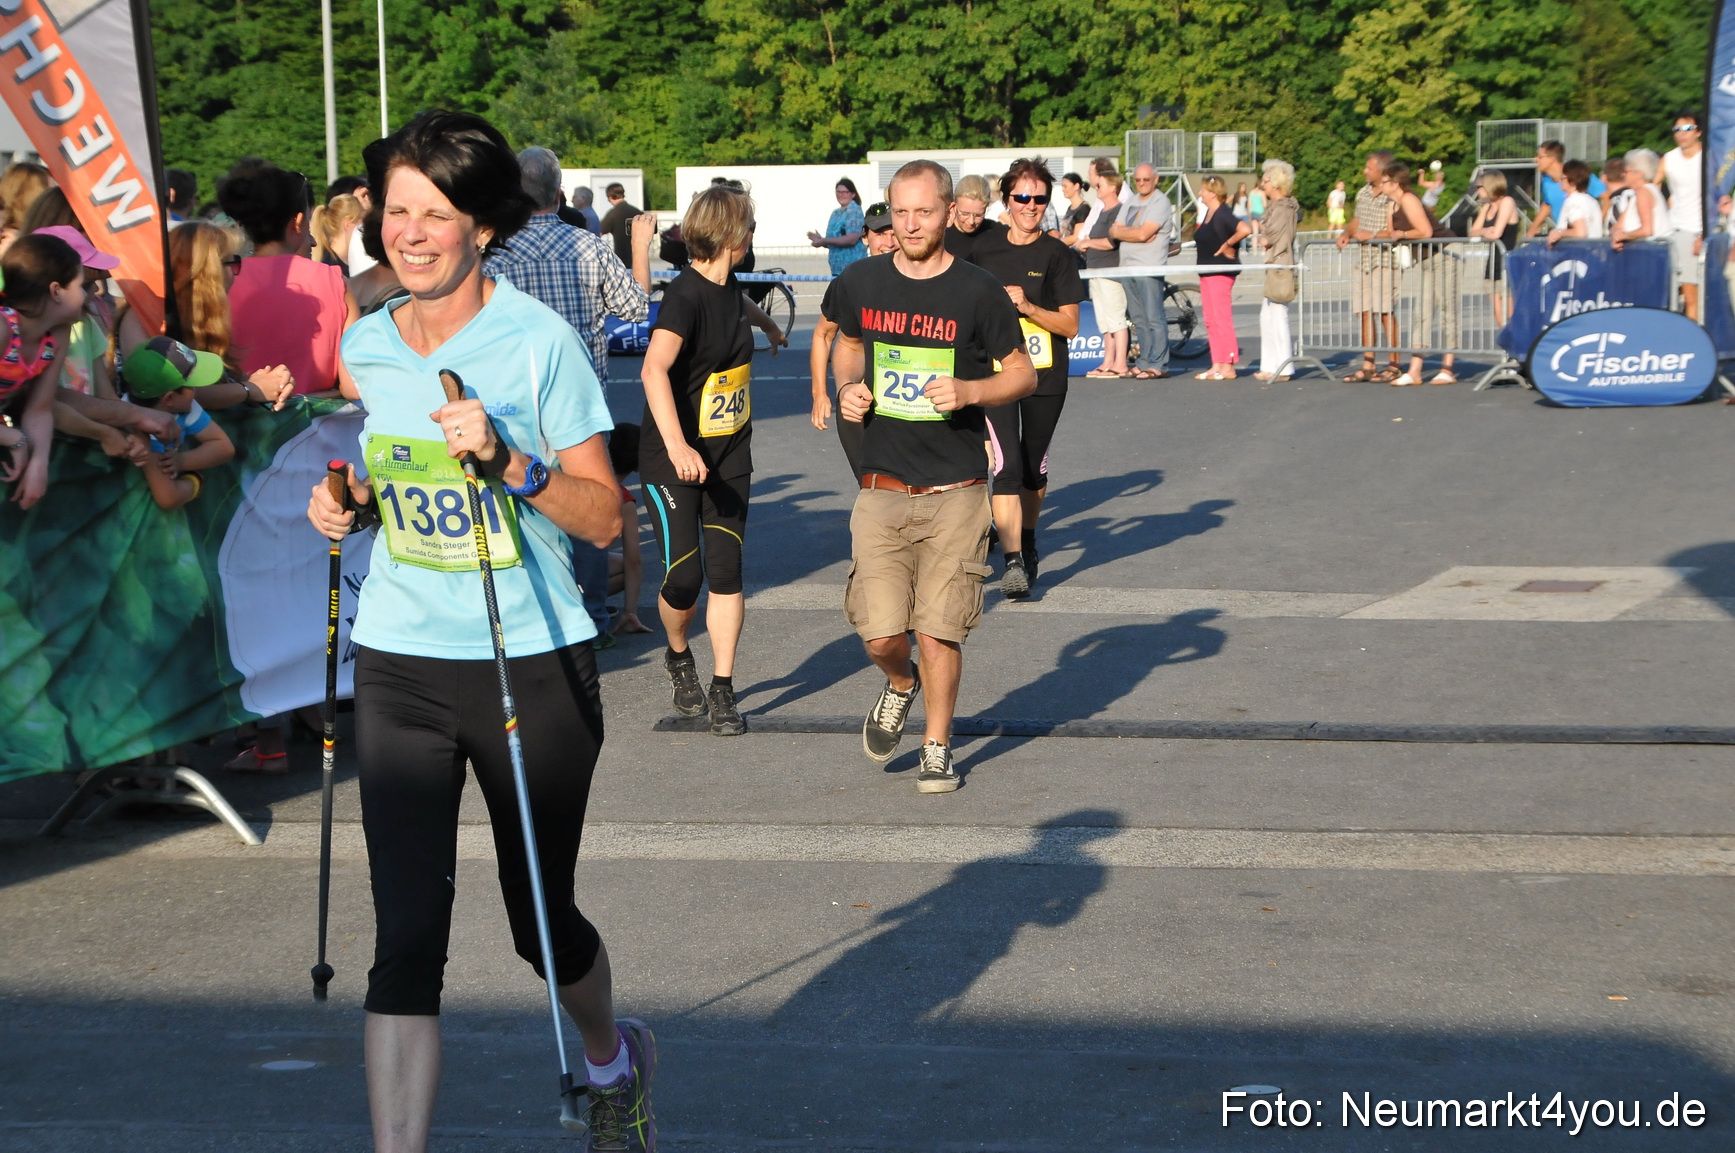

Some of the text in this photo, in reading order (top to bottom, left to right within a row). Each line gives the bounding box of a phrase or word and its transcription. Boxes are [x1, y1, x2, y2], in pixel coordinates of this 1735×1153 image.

[1549, 290, 1634, 323] Fisch
[861, 307, 957, 341] MANU CHAO
[621, 336, 649, 349] Fis
[1029, 335, 1041, 356] 8
[1066, 333, 1105, 350] he
[1067, 351, 1105, 359] MOBILE
[1576, 349, 1695, 376] Fischer
[1588, 372, 1686, 387] AUTOMOBILE
[484, 401, 517, 417] mida
[710, 388, 745, 420] 248
[385, 458, 429, 472] firmenlauf
[430, 469, 457, 478] 2014
[380, 484, 501, 538] 1381
[420, 539, 471, 550] Sandra Steger
[405, 547, 494, 561] Sumida Components GH
